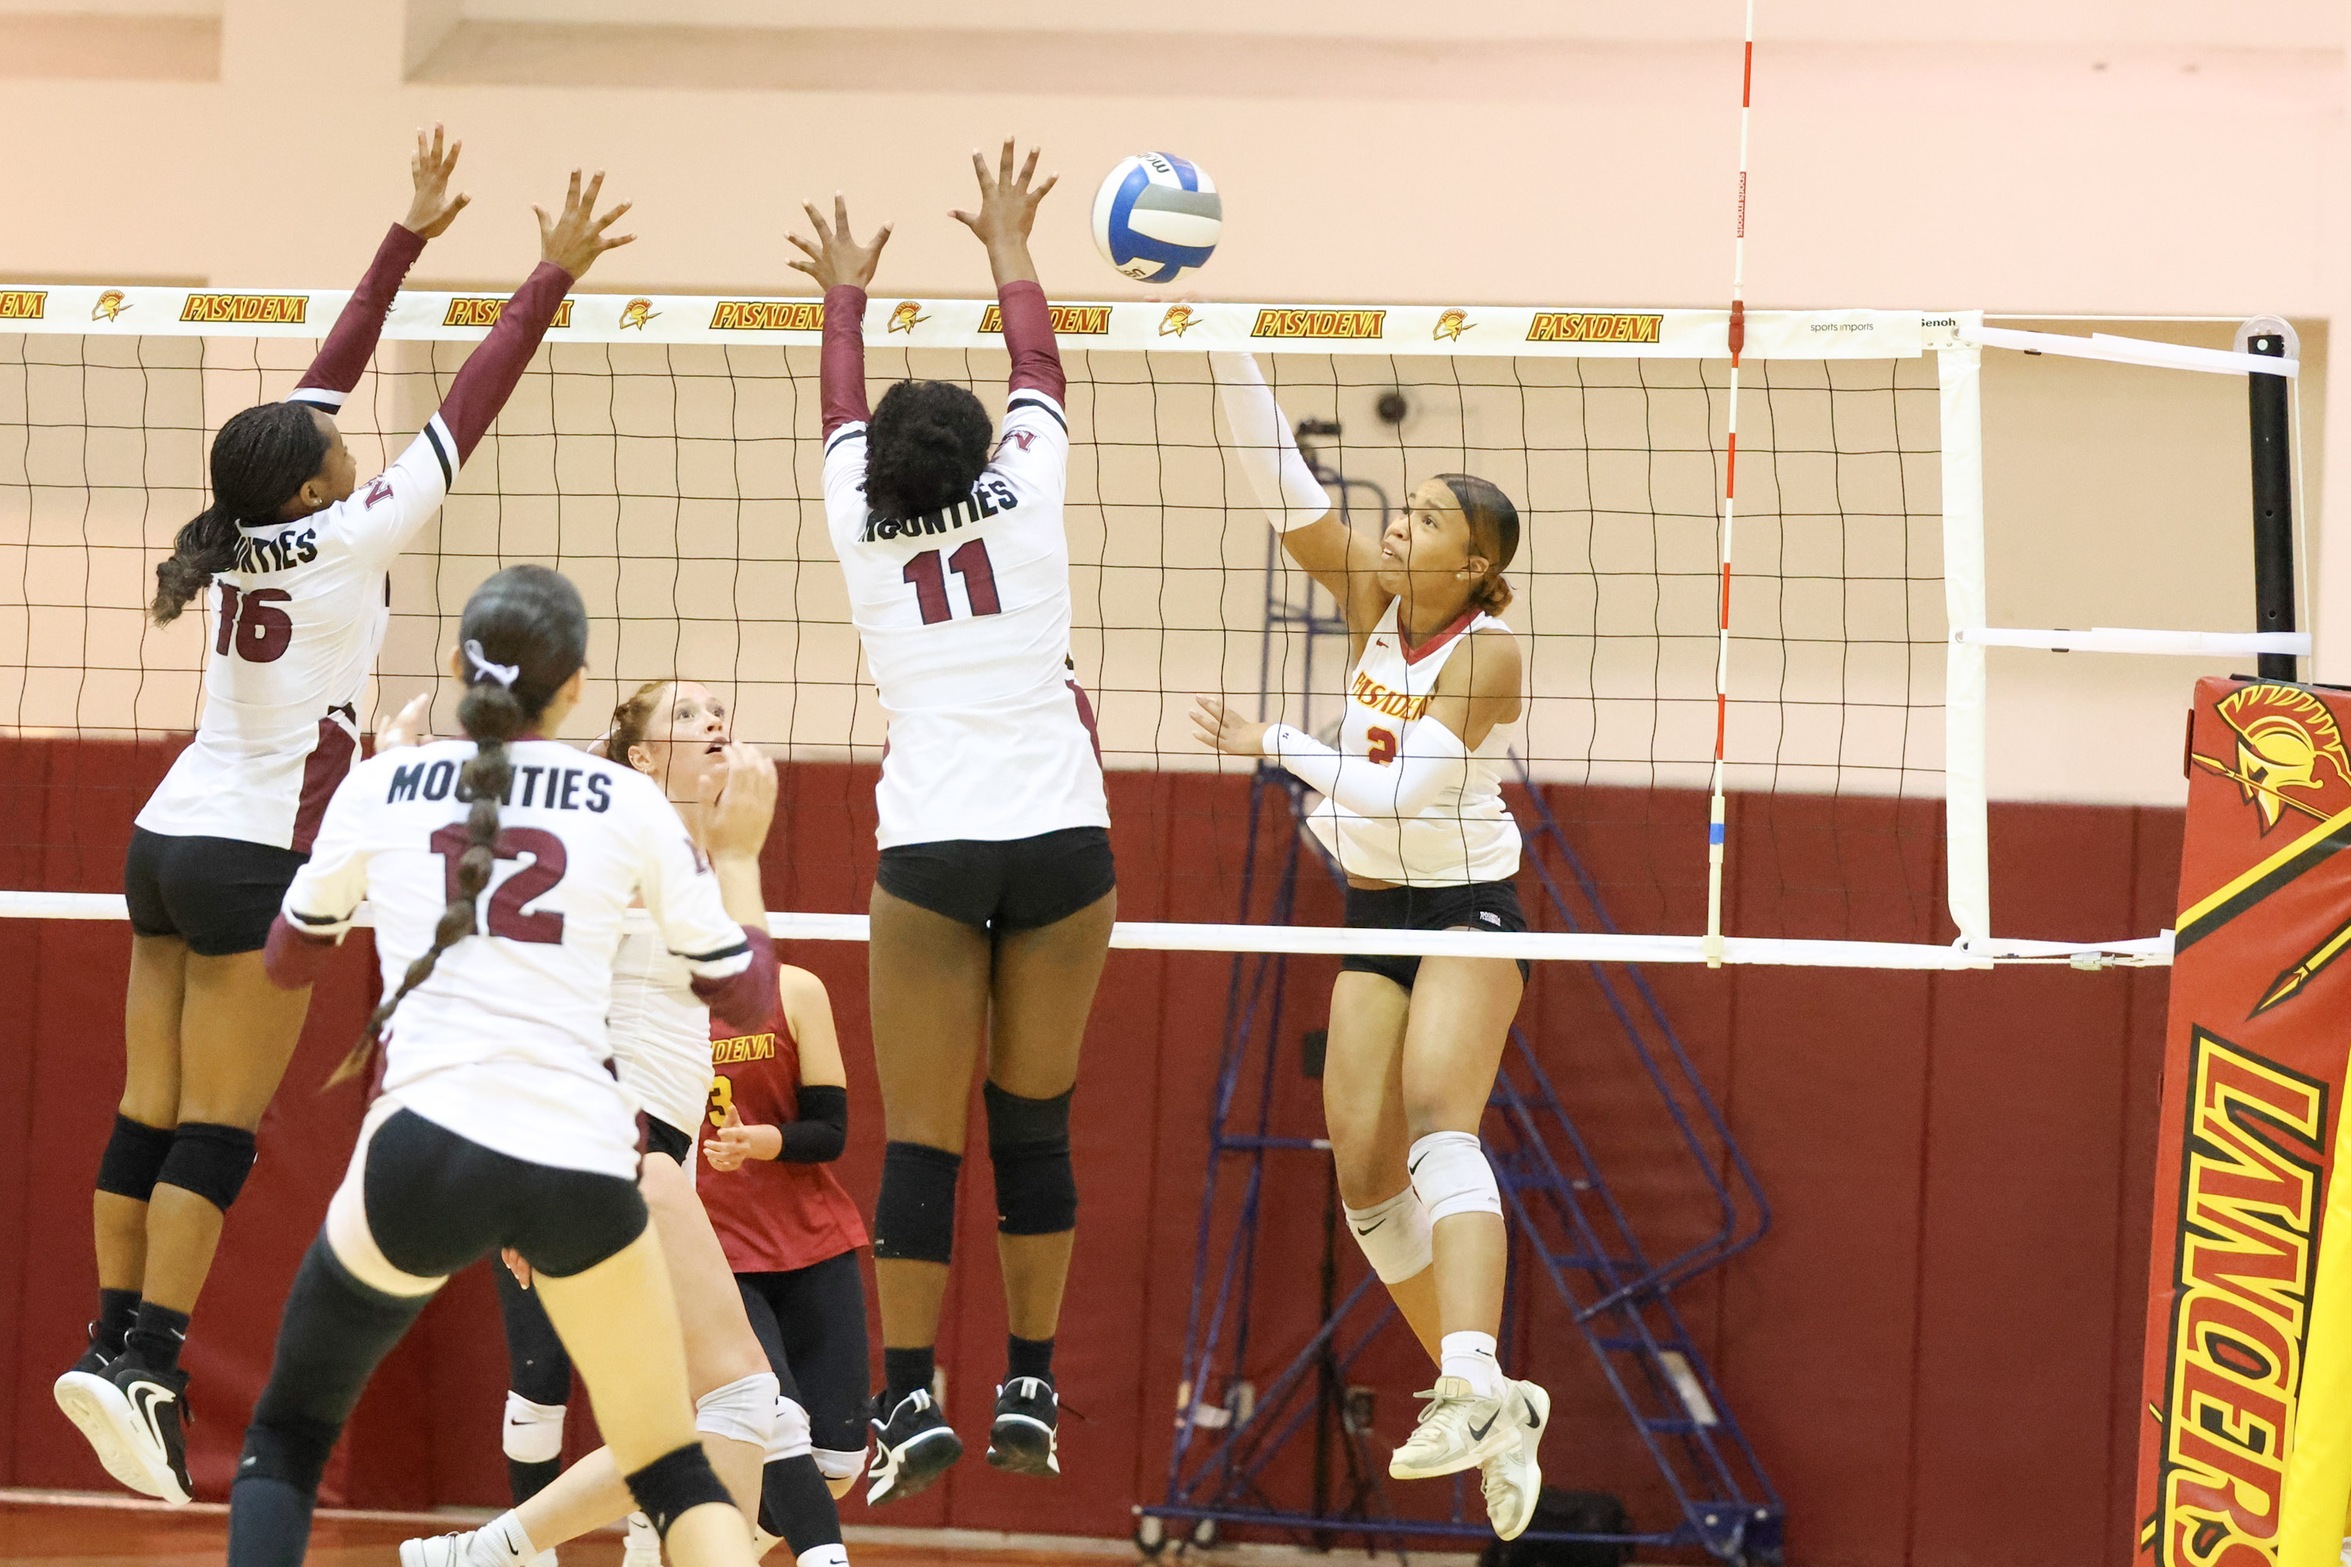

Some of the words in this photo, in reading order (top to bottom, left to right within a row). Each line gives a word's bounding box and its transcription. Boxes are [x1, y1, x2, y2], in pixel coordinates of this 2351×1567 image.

[0, 290, 48, 319] ENA
[180, 293, 309, 324] PASADENA
[709, 301, 824, 331] PASADEN
[978, 304, 1113, 334] PDENA
[1251, 308, 1386, 339] PASADENA
[1526, 312, 1664, 343] PASADENA
[1810, 322, 1838, 333] sports
[1839, 322, 1874, 332] imports
[903, 537, 1002, 625] 11
[216, 578, 293, 663] 16
[1350, 669, 1429, 722] PASADEN
[1367, 726, 1398, 766] 2
[430, 823, 567, 944] 12
[711, 1033, 775, 1065] DENA
